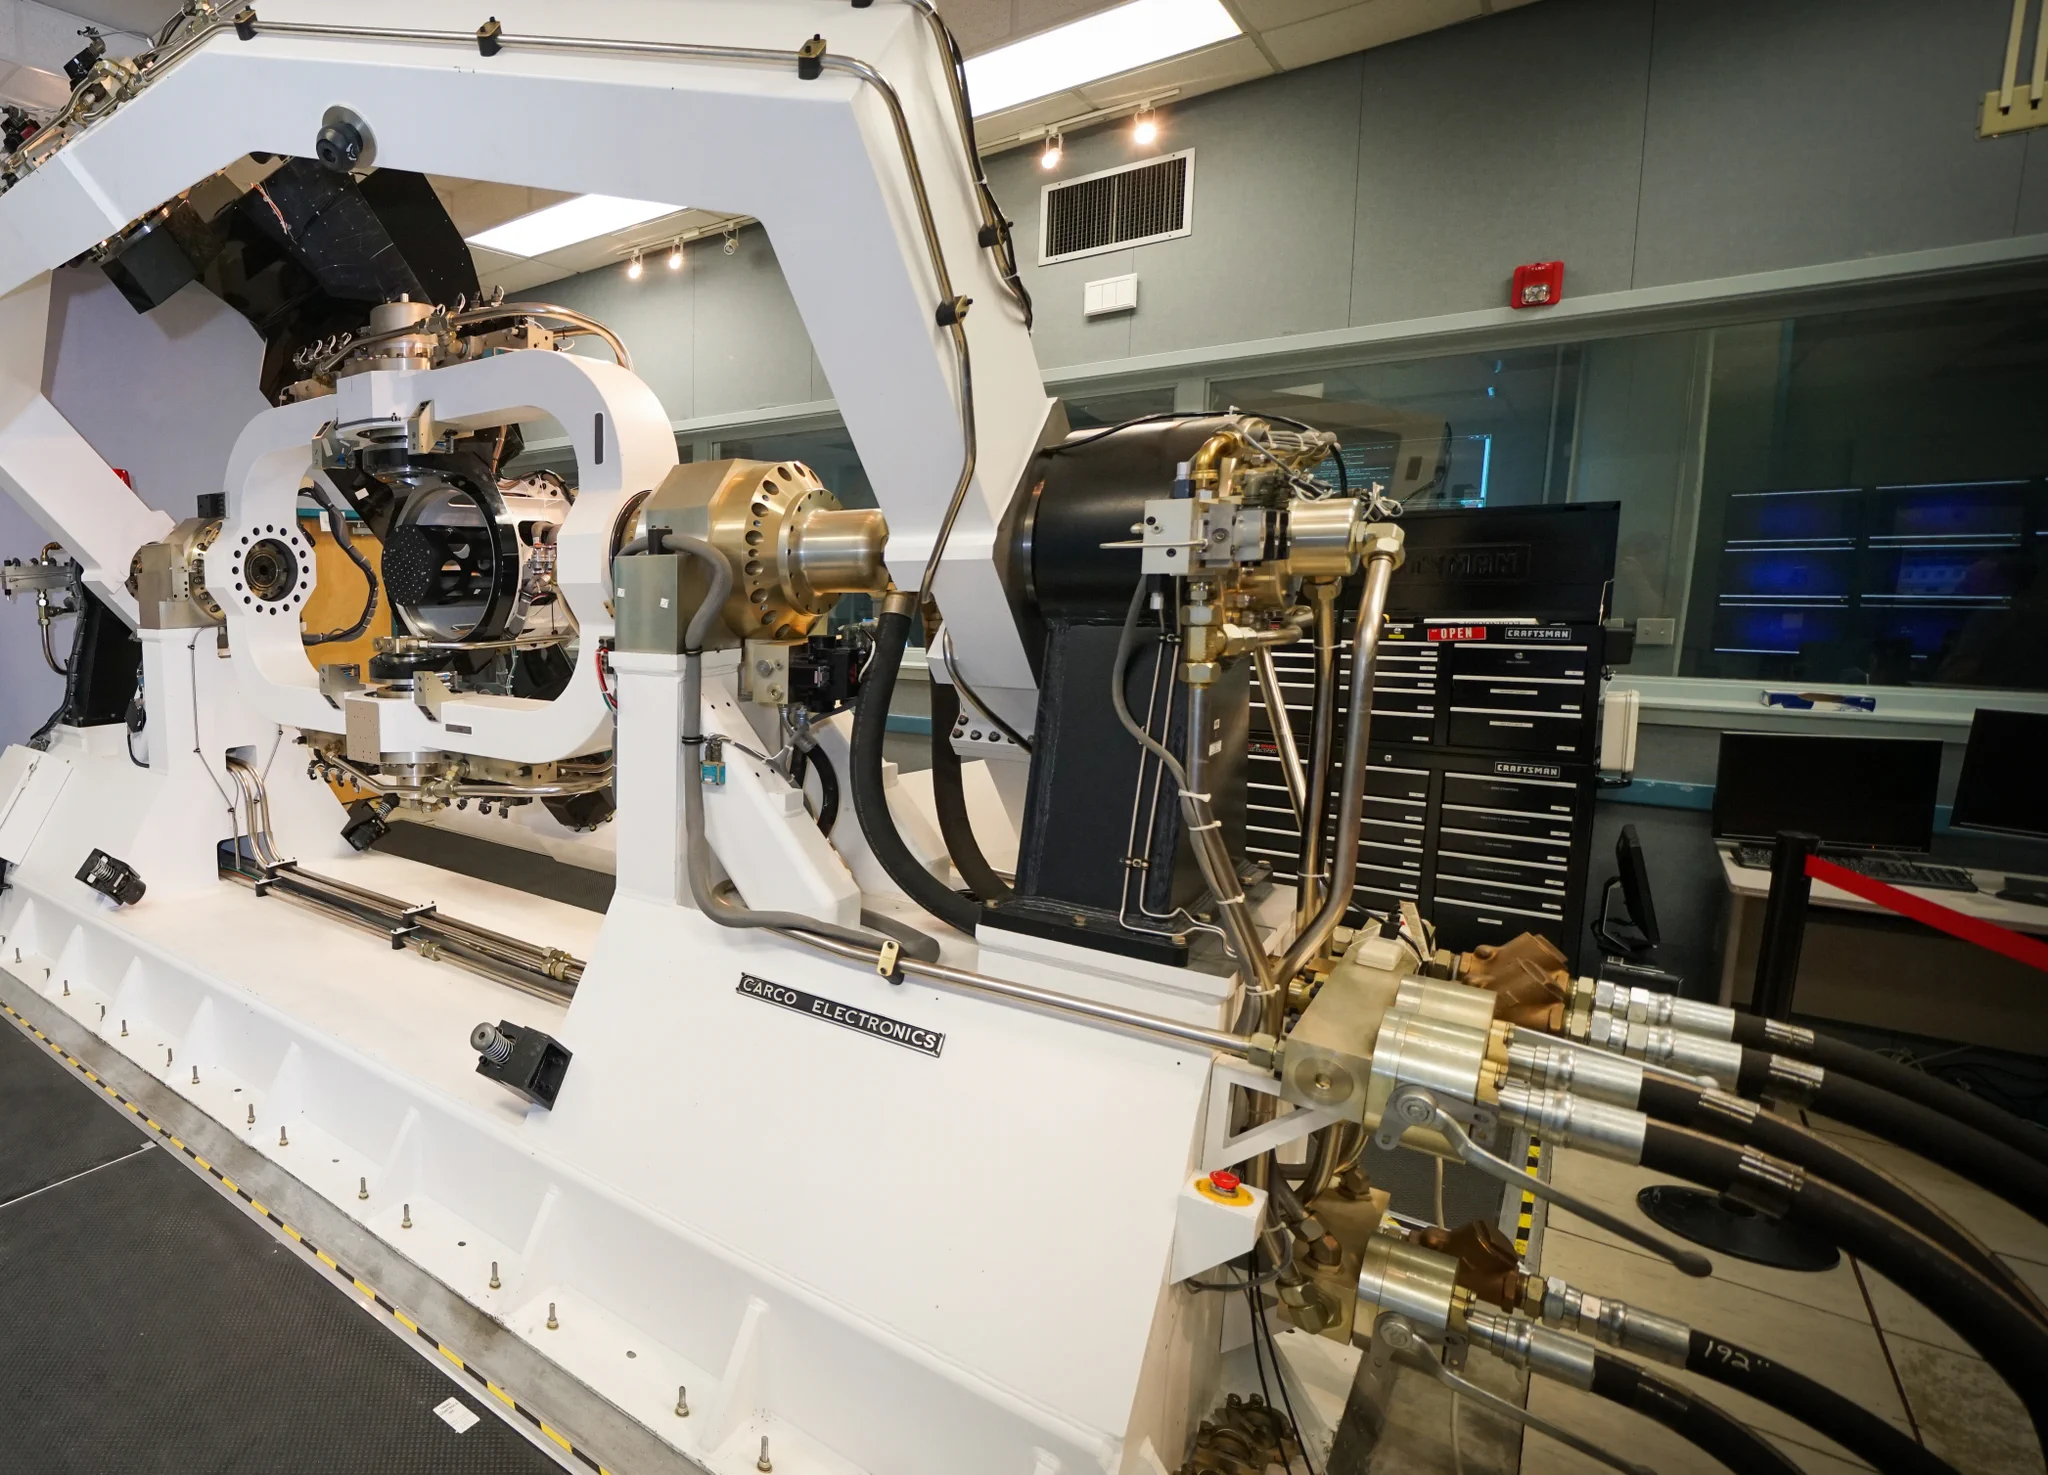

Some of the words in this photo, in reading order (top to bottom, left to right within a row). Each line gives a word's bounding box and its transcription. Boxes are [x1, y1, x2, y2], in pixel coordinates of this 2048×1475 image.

[1440, 627, 1473, 639] OPEN
[1507, 629, 1569, 638] CRAFTSMAN
[1497, 764, 1557, 776] CRAFTSMAN
[743, 978, 797, 1005] CARCO
[812, 1000, 937, 1049] ELECTRONICS
